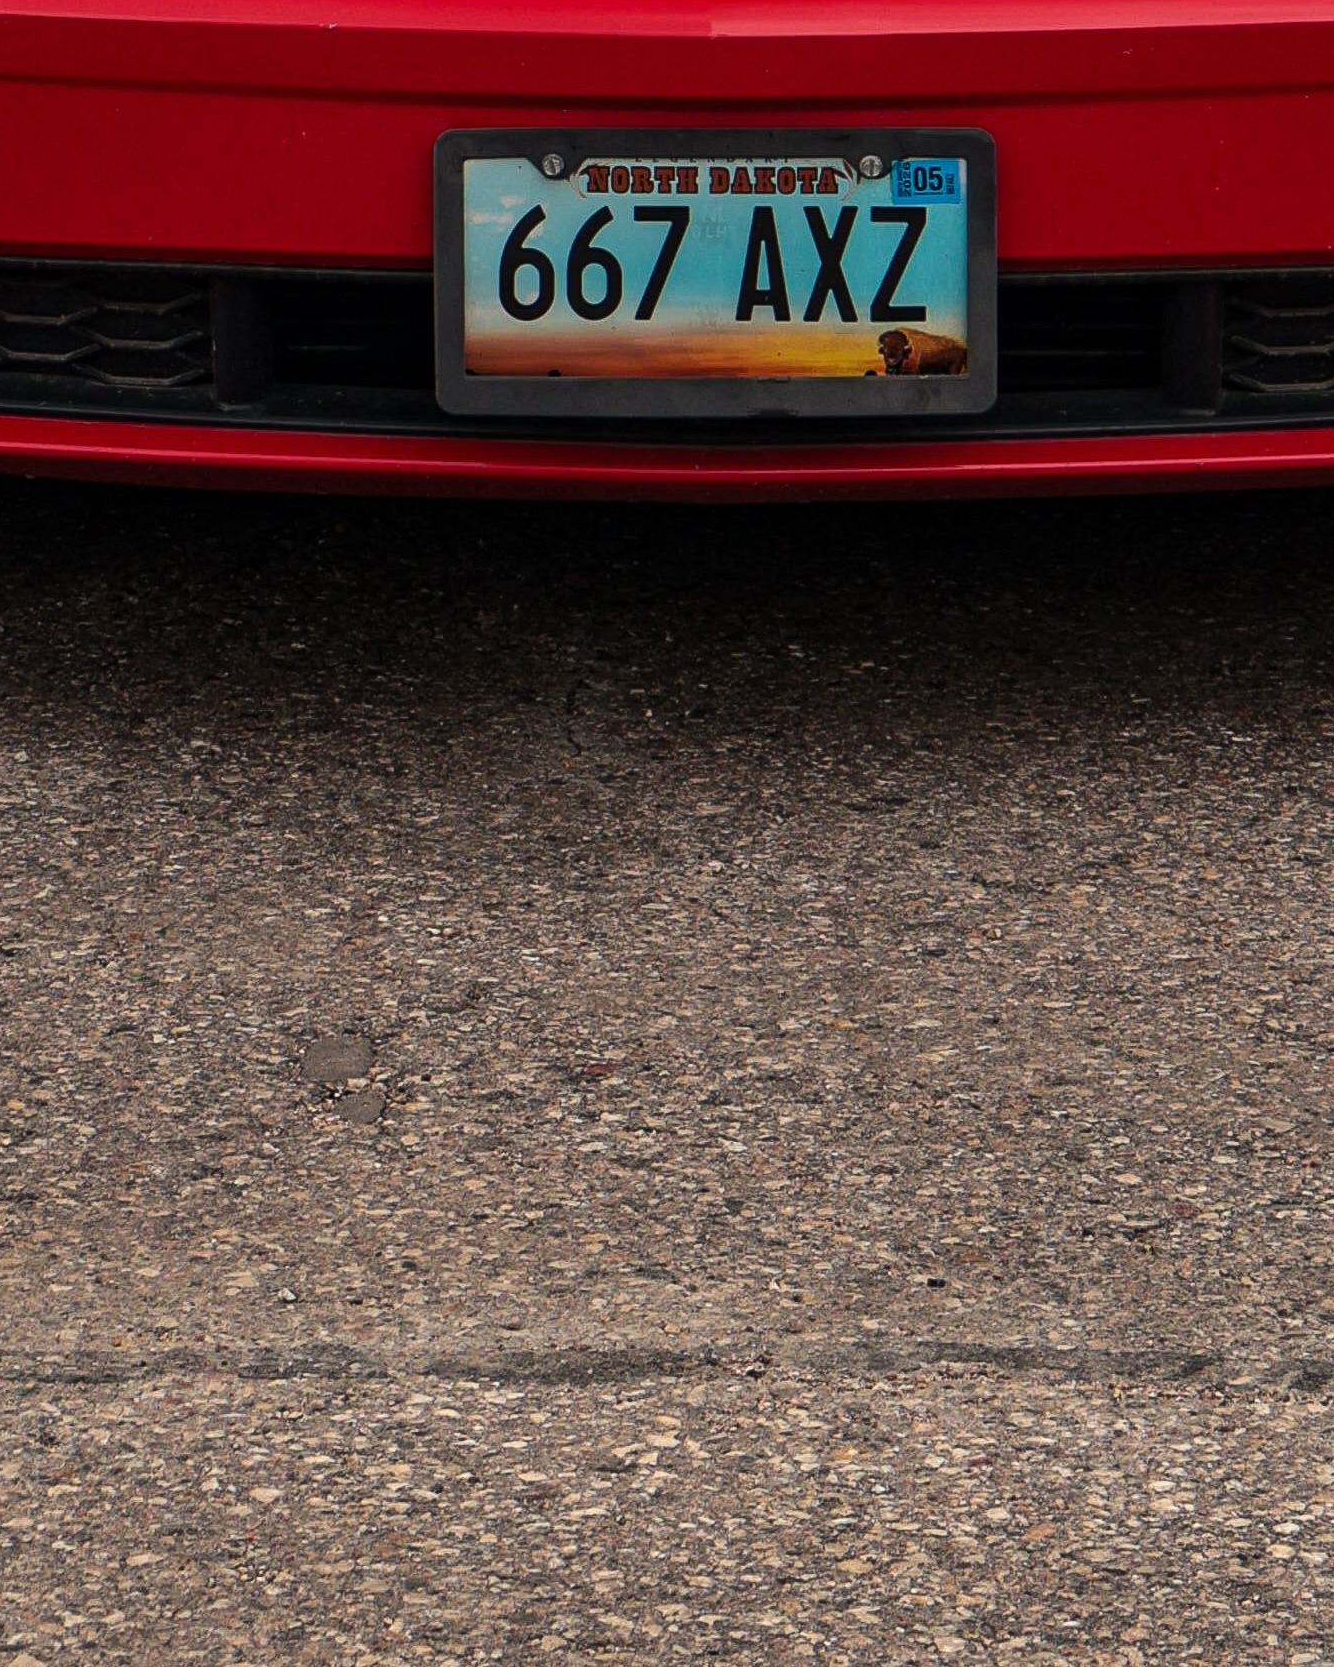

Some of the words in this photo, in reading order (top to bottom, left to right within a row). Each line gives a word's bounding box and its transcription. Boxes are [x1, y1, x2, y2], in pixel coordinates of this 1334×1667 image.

[586, 165, 699, 195] NORTH
[708, 166, 839, 195] DAKOTA
[913, 166, 943, 192] 05
[498, 204, 691, 322] 667
[735, 204, 927, 323] AXZ
